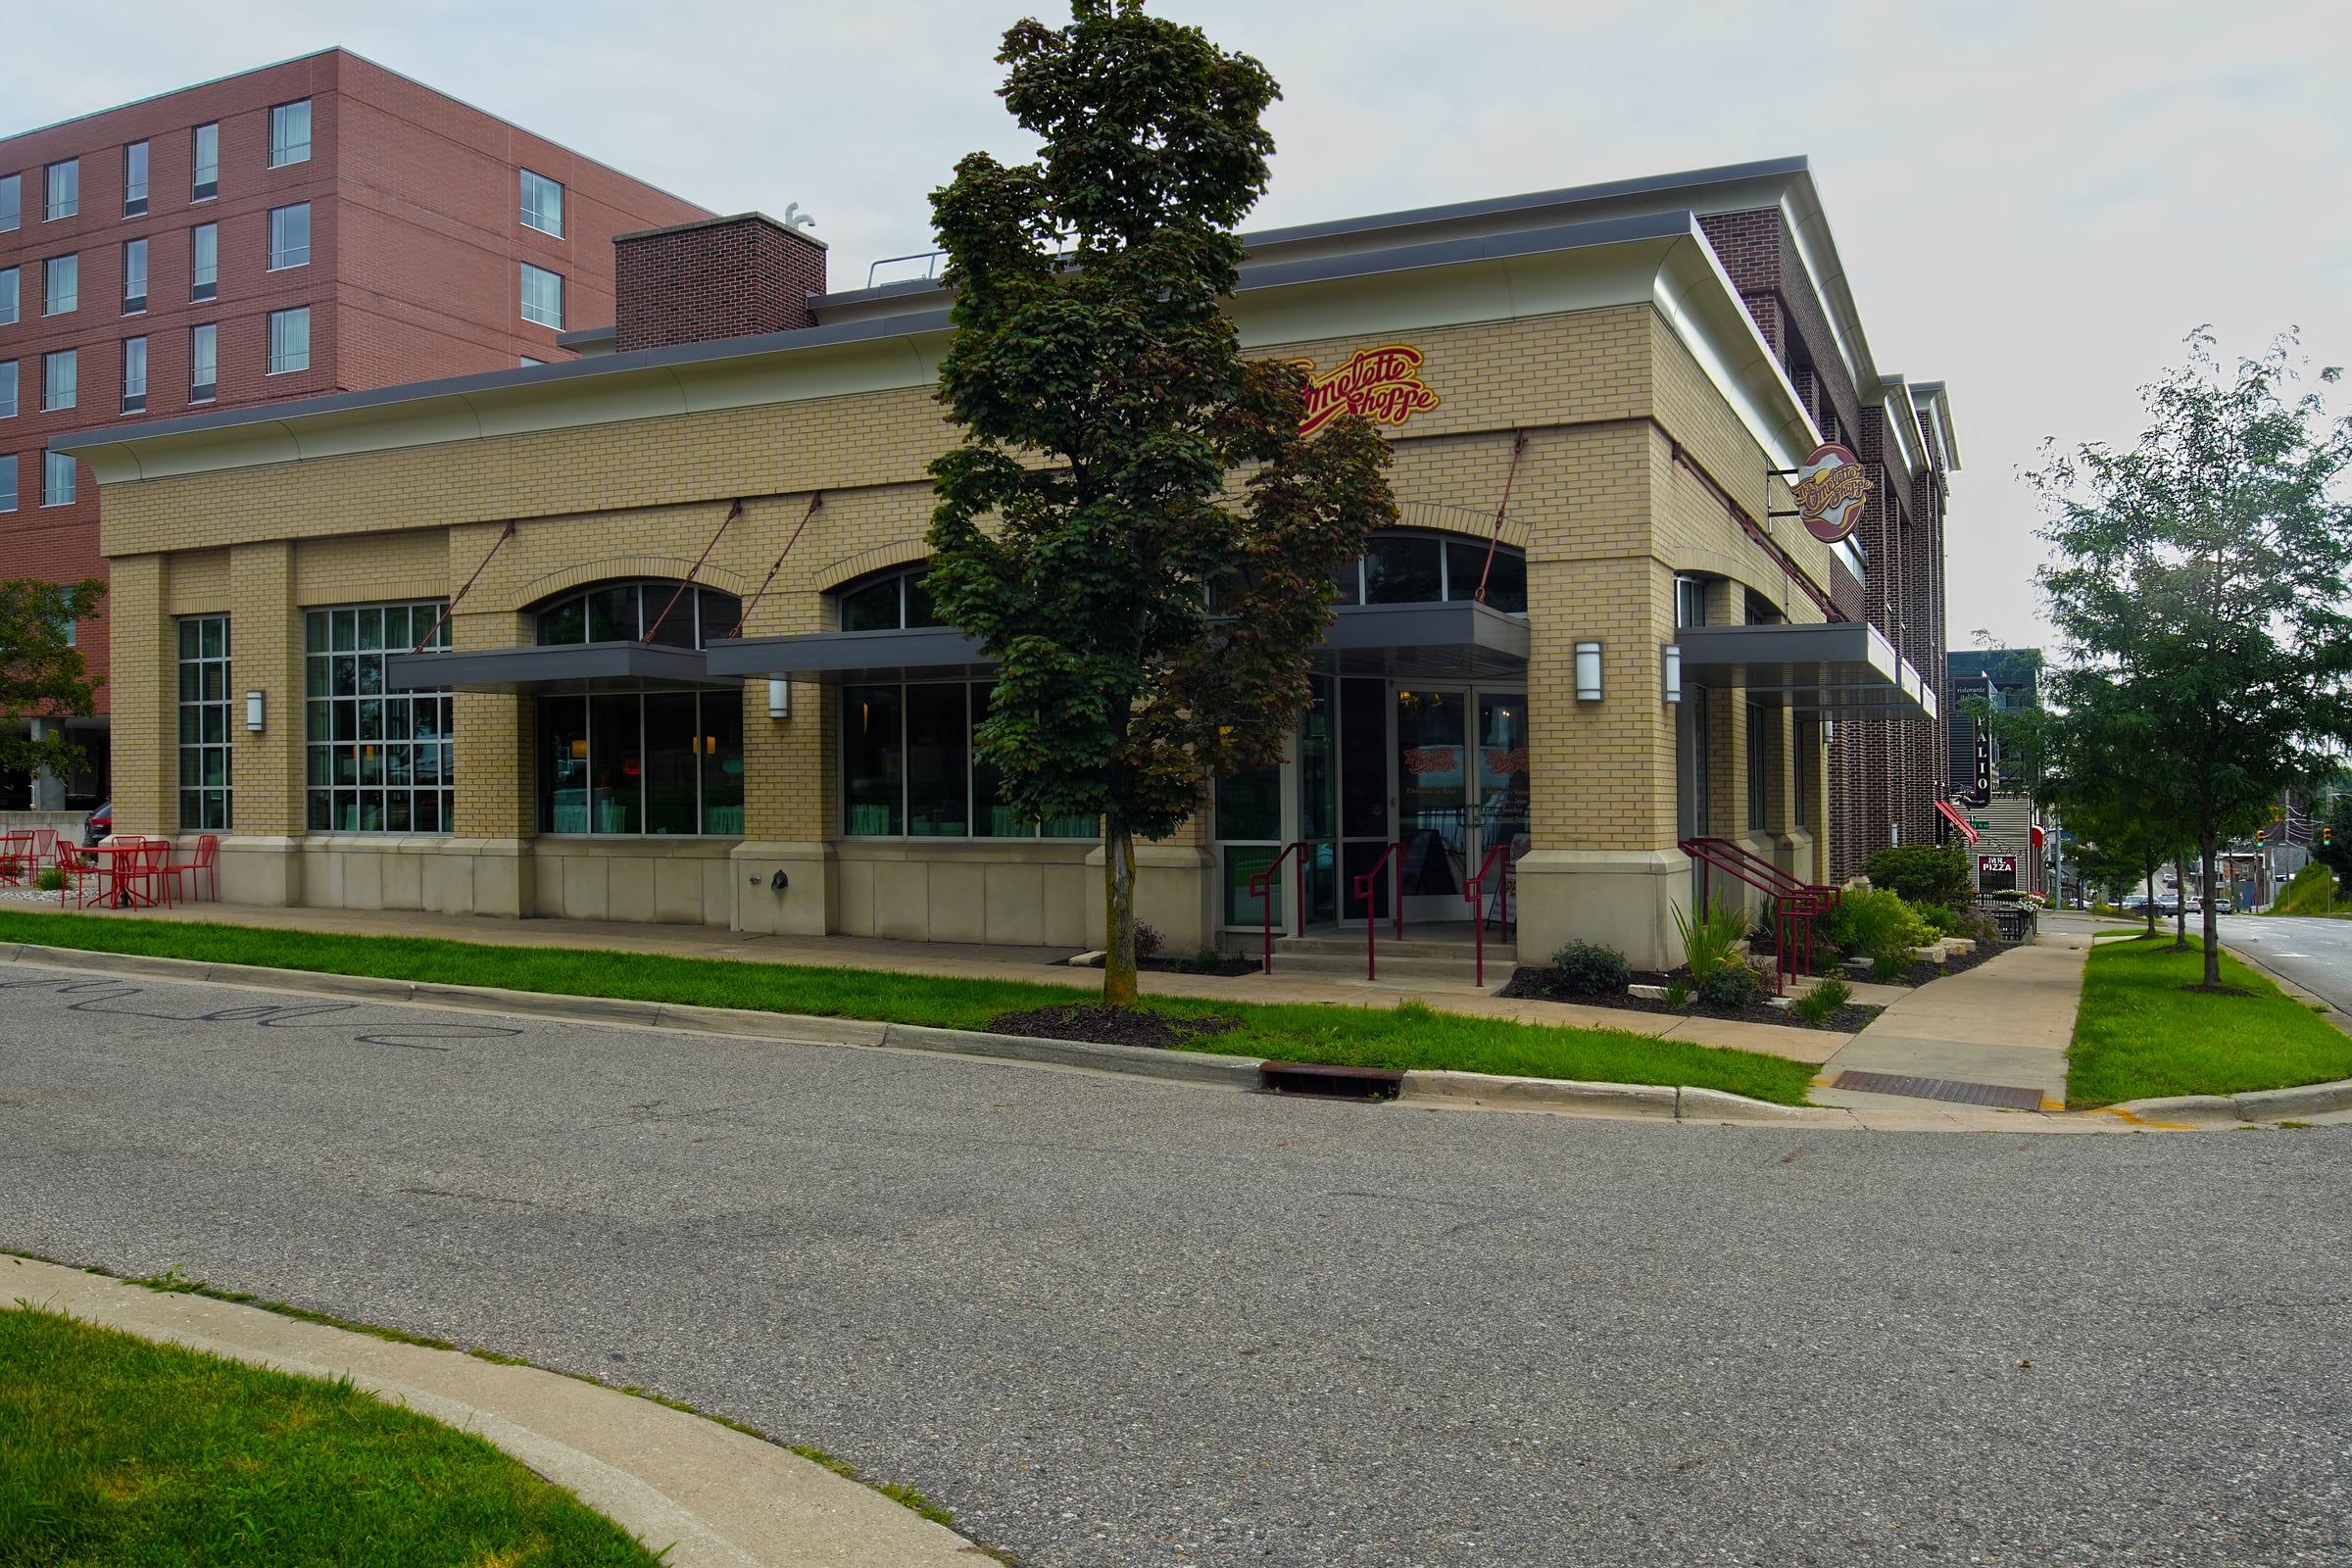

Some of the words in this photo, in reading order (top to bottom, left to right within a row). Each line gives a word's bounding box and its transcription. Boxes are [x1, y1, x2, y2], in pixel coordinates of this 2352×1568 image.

[1803, 463, 1865, 516] Omelette
[1830, 477, 1874, 509] Shoppe
[1977, 714, 1988, 790] PALIO
[1987, 856, 2007, 864] MR.
